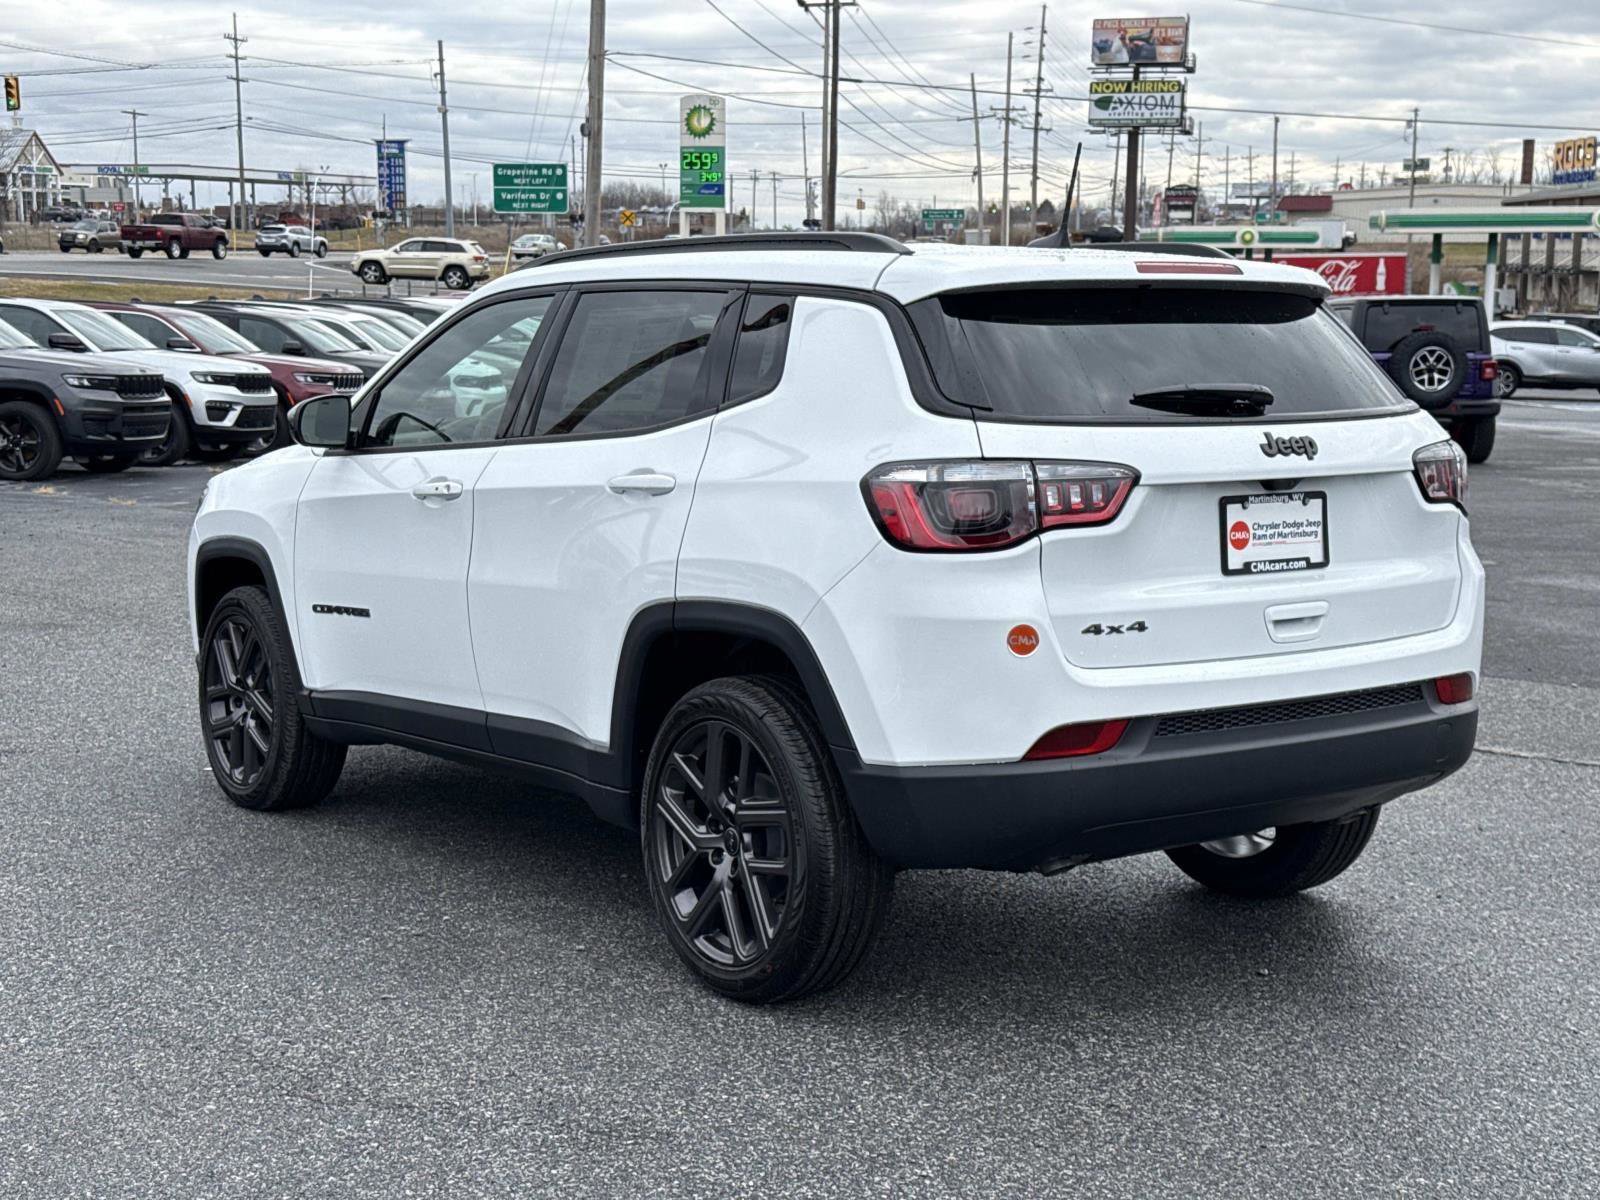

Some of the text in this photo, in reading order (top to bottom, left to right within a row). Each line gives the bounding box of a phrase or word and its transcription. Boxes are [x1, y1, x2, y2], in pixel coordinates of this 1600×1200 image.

[1092, 82, 1179, 93] NOW HIRING
[1111, 95, 1175, 111] AXIOM
[497, 168, 538, 176] Grapevine
[501, 192, 550, 200] Variform Dr
[1259, 431, 1318, 460] Jeep
[1248, 493, 1305, 504] Martinsburg, WV
[1252, 519, 1321, 532] Chrysler Dodge Jeep
[1230, 531, 1250, 539] CMA's
[1252, 528, 1318, 540] Ram of Martinsburg
[1251, 561, 1307, 573] CMAcars.com
[1081, 620, 1148, 636] 4x4
[1009, 635, 1036, 646] CMA
